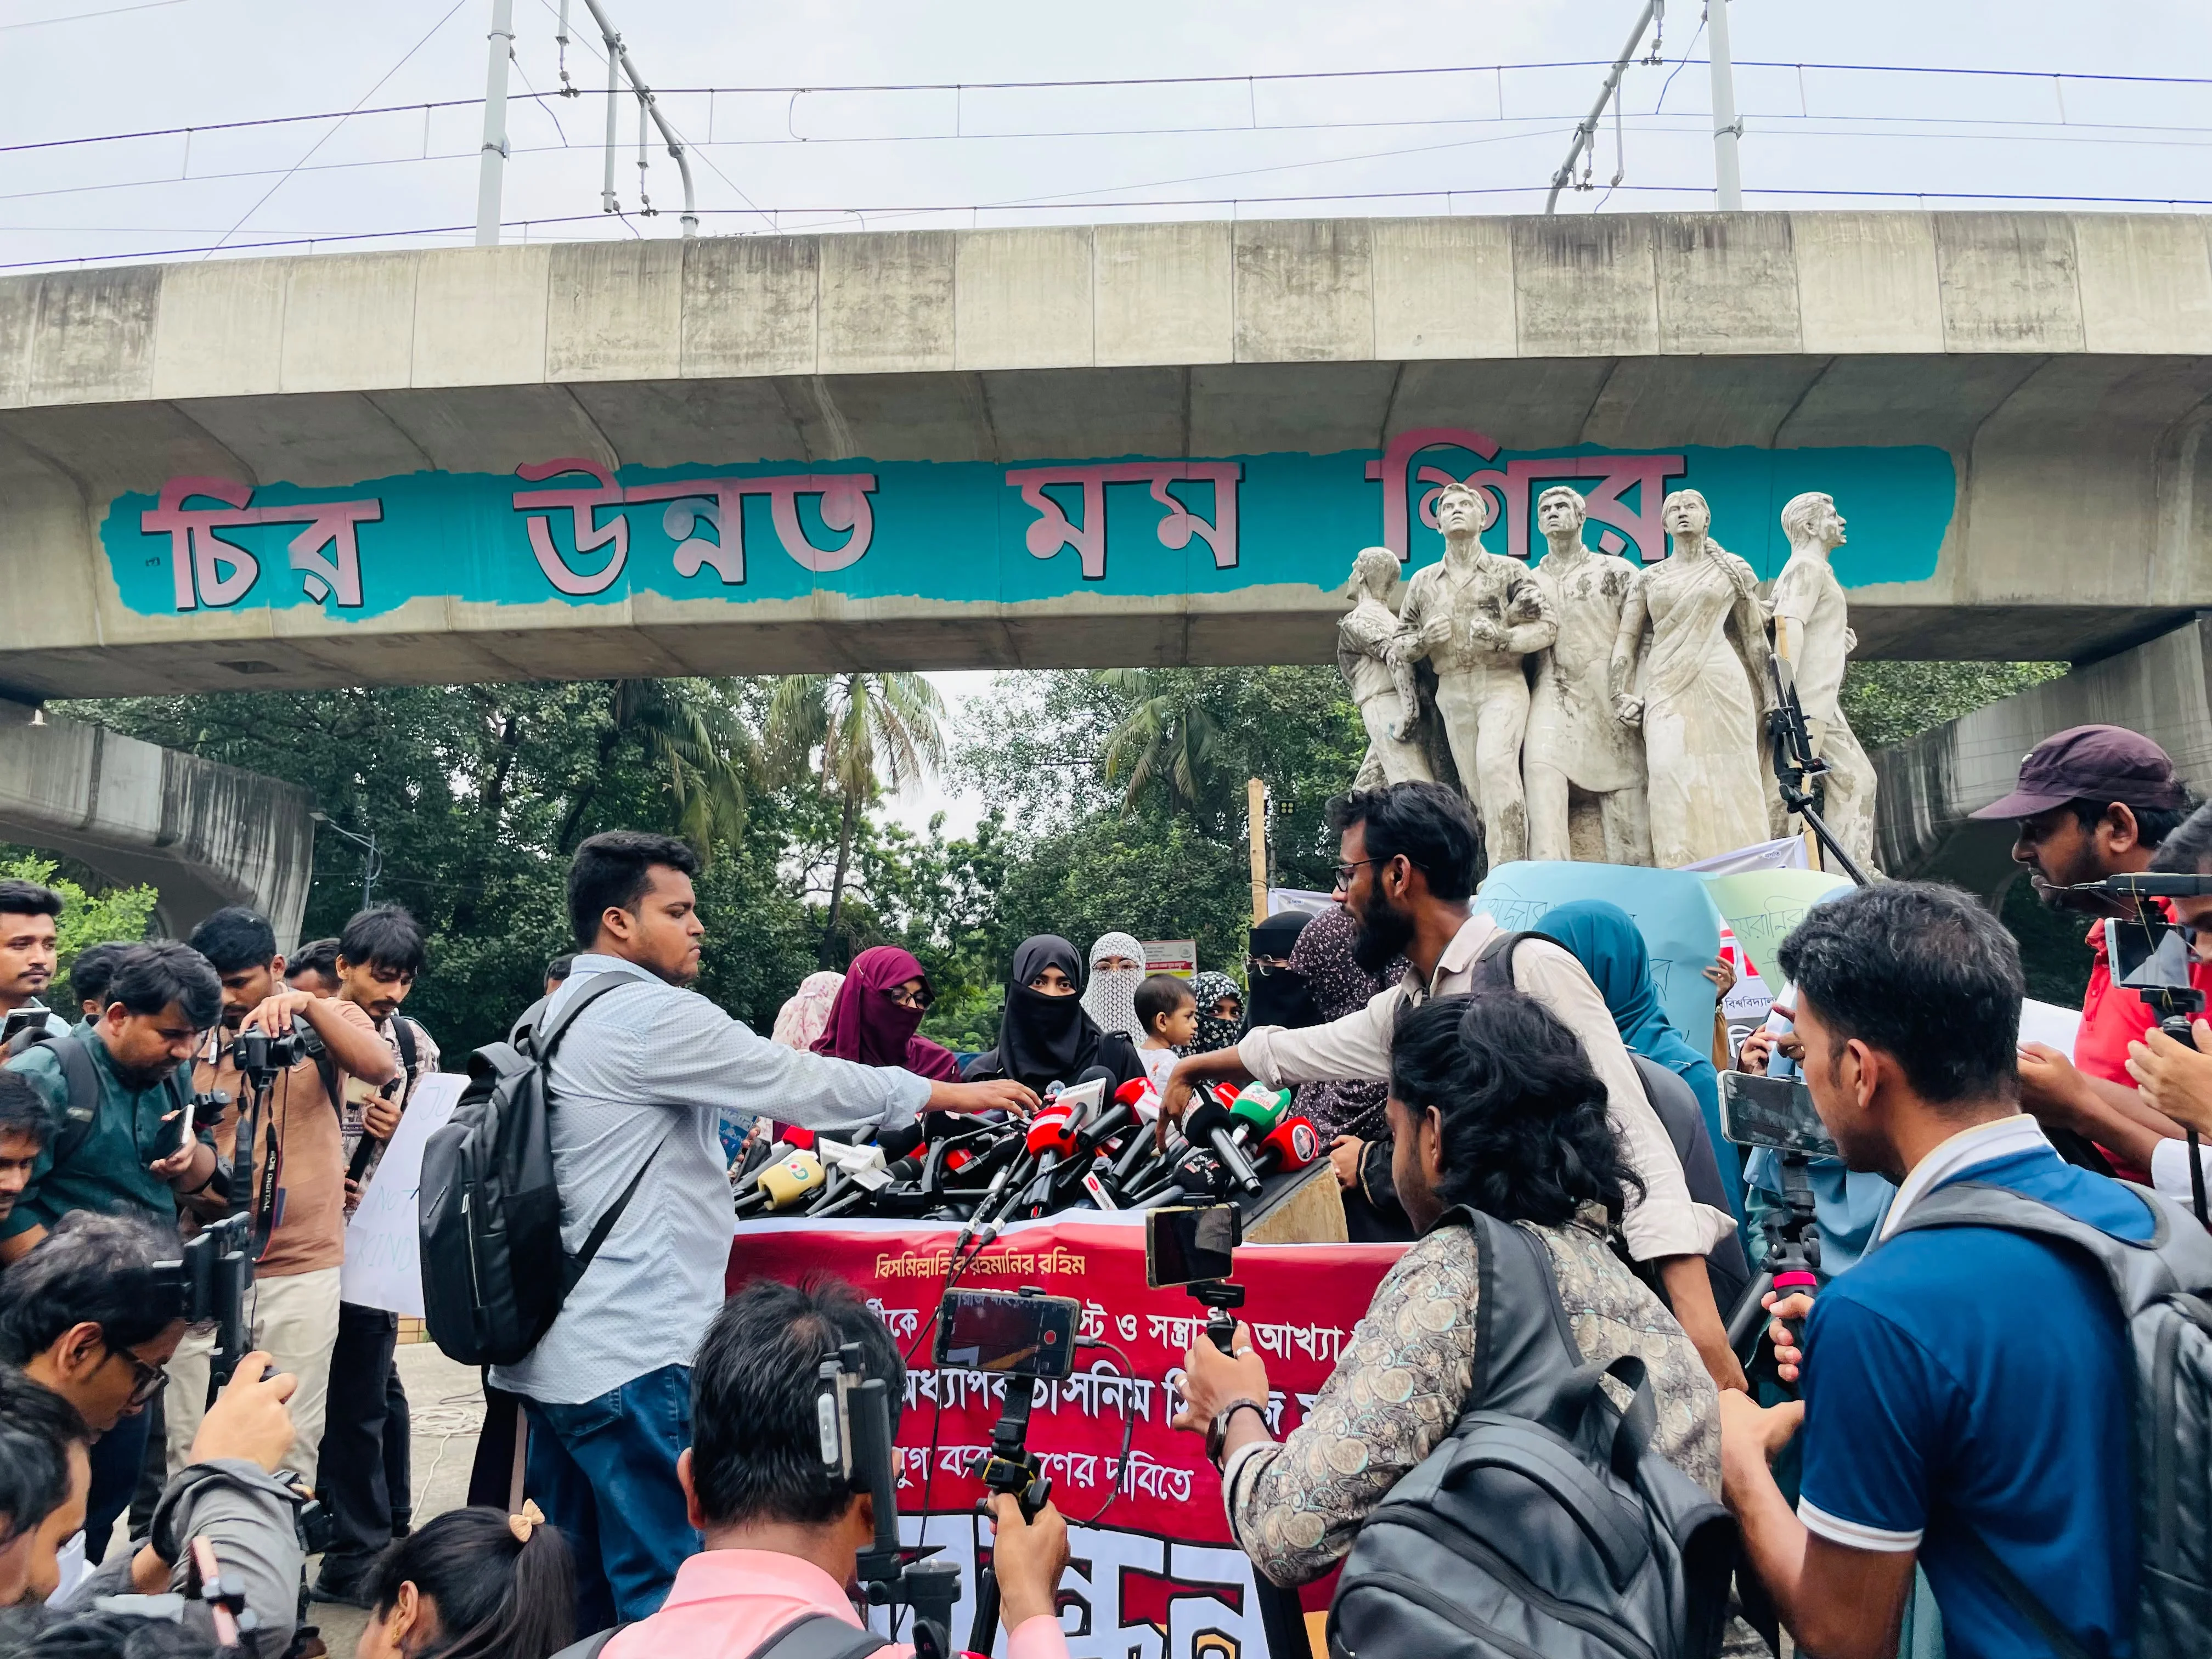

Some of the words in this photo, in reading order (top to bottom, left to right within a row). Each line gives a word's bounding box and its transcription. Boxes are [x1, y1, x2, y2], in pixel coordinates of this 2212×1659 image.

[140, 475, 383, 612] চির
[513, 457, 879, 596] উন্নত
[1005, 461, 1243, 581] মম
[1365, 427, 1686, 563] শির
[1724, 996, 1778, 1011] বিশ্ববিদ্যাল
[268, 1150, 276, 1171] EOS
[263, 1173, 273, 1212] DIGITAL
[374, 1185, 416, 1217] NOT
[874, 1250, 966, 1279] বিসমিল্লাহির
[969, 1247, 1035, 1277] রহমানির
[1037, 1246, 1086, 1276] রহিম
[1115, 1313, 1137, 1342] ও
[1251, 1321, 1345, 1362] আখ্যা
[1031, 1359, 1156, 1423] তাসনিম
[1104, 1449, 1194, 1502] দাবিতে
